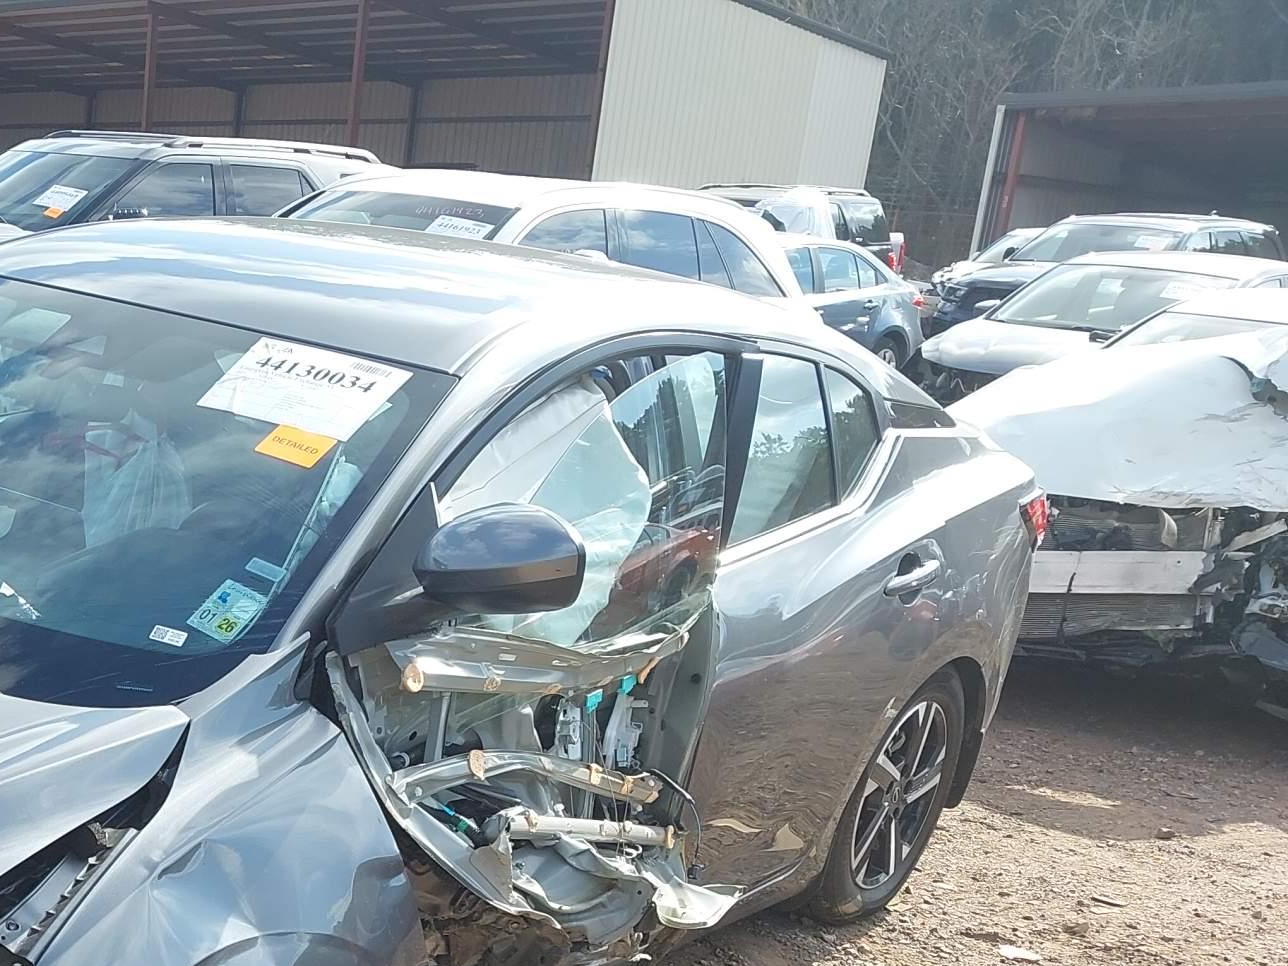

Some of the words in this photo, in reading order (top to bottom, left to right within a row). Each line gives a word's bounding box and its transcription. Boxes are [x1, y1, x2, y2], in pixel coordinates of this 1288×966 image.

[256, 356, 377, 393] 44130034
[271, 434, 319, 455] DETAILED
[199, 608, 218, 624] 01
[216, 617, 238, 634] 26
